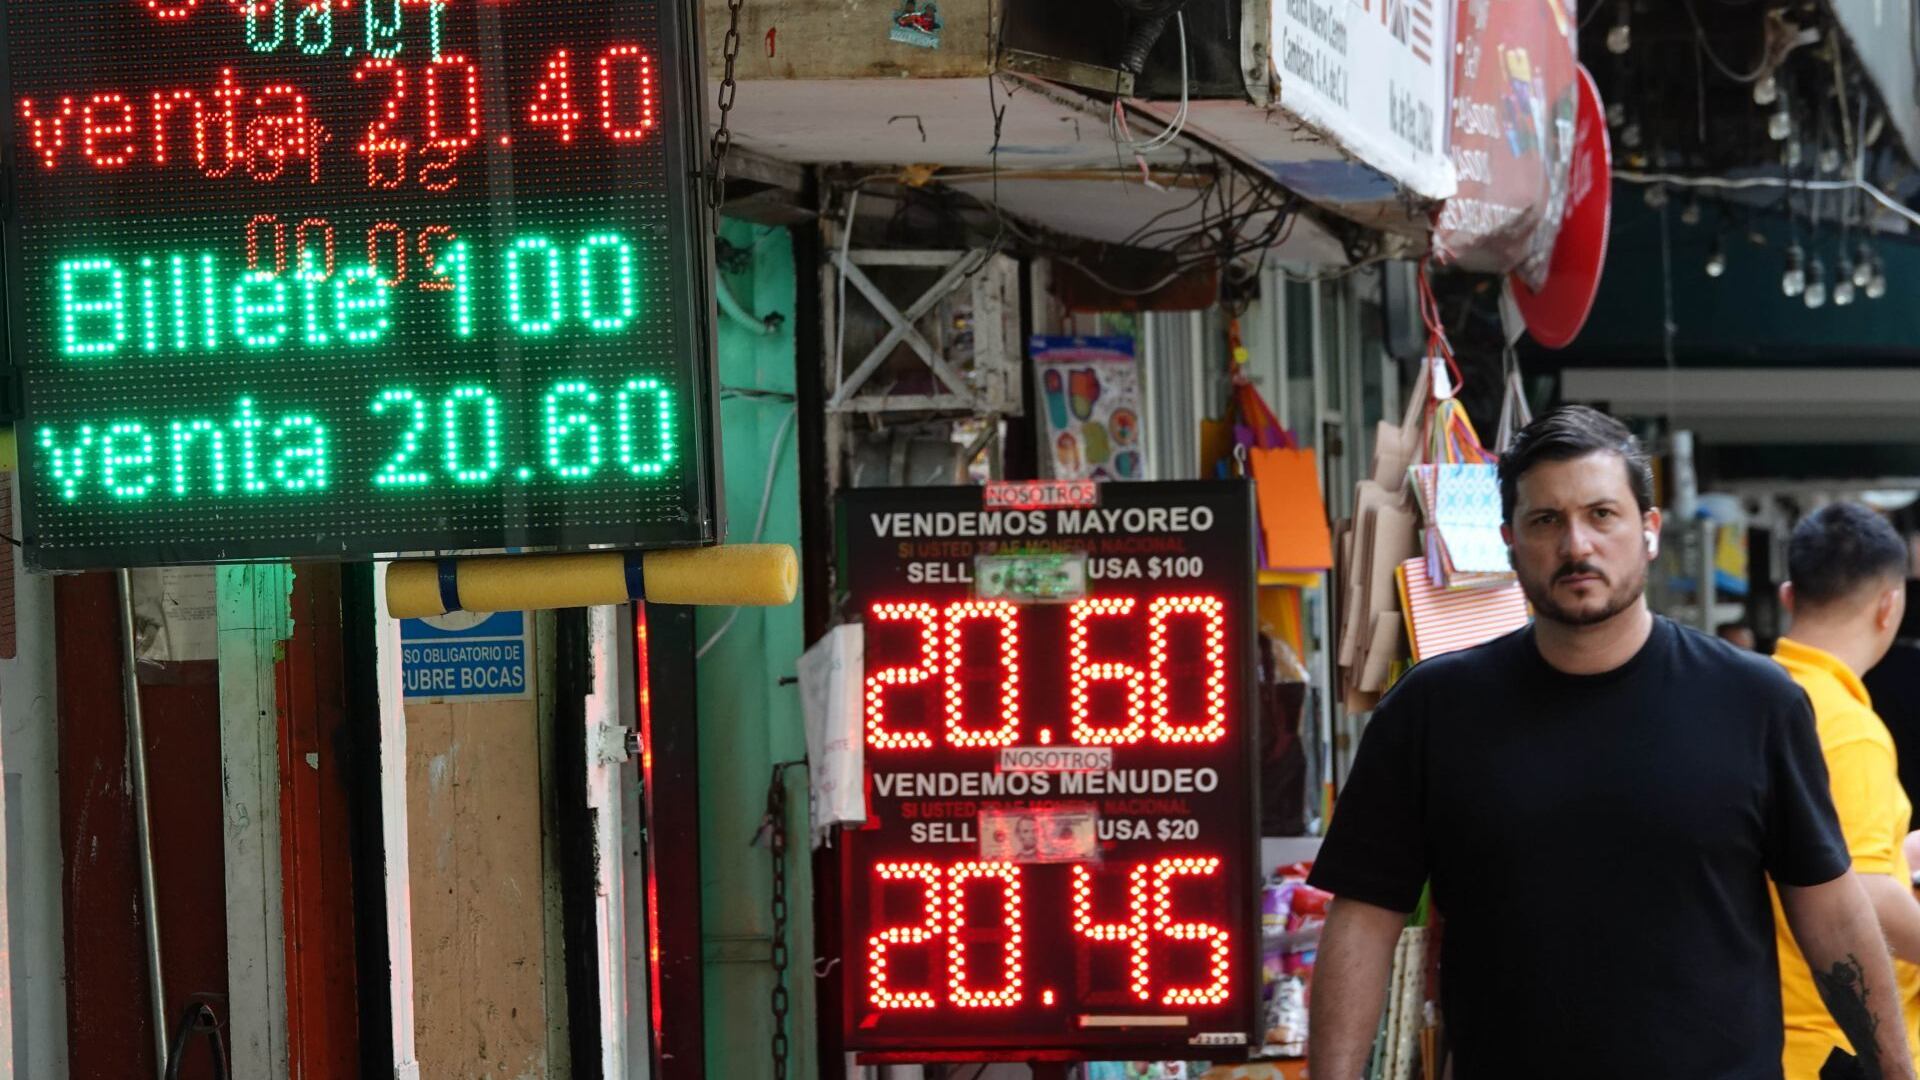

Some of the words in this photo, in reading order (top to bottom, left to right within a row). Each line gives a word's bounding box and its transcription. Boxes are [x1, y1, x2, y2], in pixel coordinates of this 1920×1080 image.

[23, 66, 305, 168] venta
[355, 47, 652, 150] 20.40
[58, 249, 389, 356] Billete
[435, 233, 637, 336] 100
[40, 396, 327, 498] venta
[373, 377, 676, 485] 20.60
[987, 484, 1094, 505] NOSOTROS
[871, 510, 1047, 537] VENDEMOS
[1057, 506, 1213, 534] MAYOREO
[898, 543, 914, 558] SI
[919, 542, 973, 558] USTED
[1101, 537, 1185, 553] NACIONAL
[907, 561, 973, 583] SELL
[1088, 558, 1142, 579] USA
[1147, 556, 1203, 580] $100
[401, 648, 420, 663] SO
[423, 646, 501, 662] OBLIGATORIO
[505, 645, 520, 660] DE
[461, 665, 523, 688] BOCAS
[866, 594, 1226, 749] 20.60
[1003, 751, 1110, 769] NOSOTROS
[873, 770, 1050, 797] VENDEMOS
[1060, 767, 1218, 794] MENUDEO
[902, 802, 917, 818] SI
[922, 801, 976, 818] USTED
[911, 822, 976, 843] SELL
[1098, 819, 1151, 840] USA
[1157, 818, 1199, 842] $20
[869, 855, 1230, 1009] 20.45
